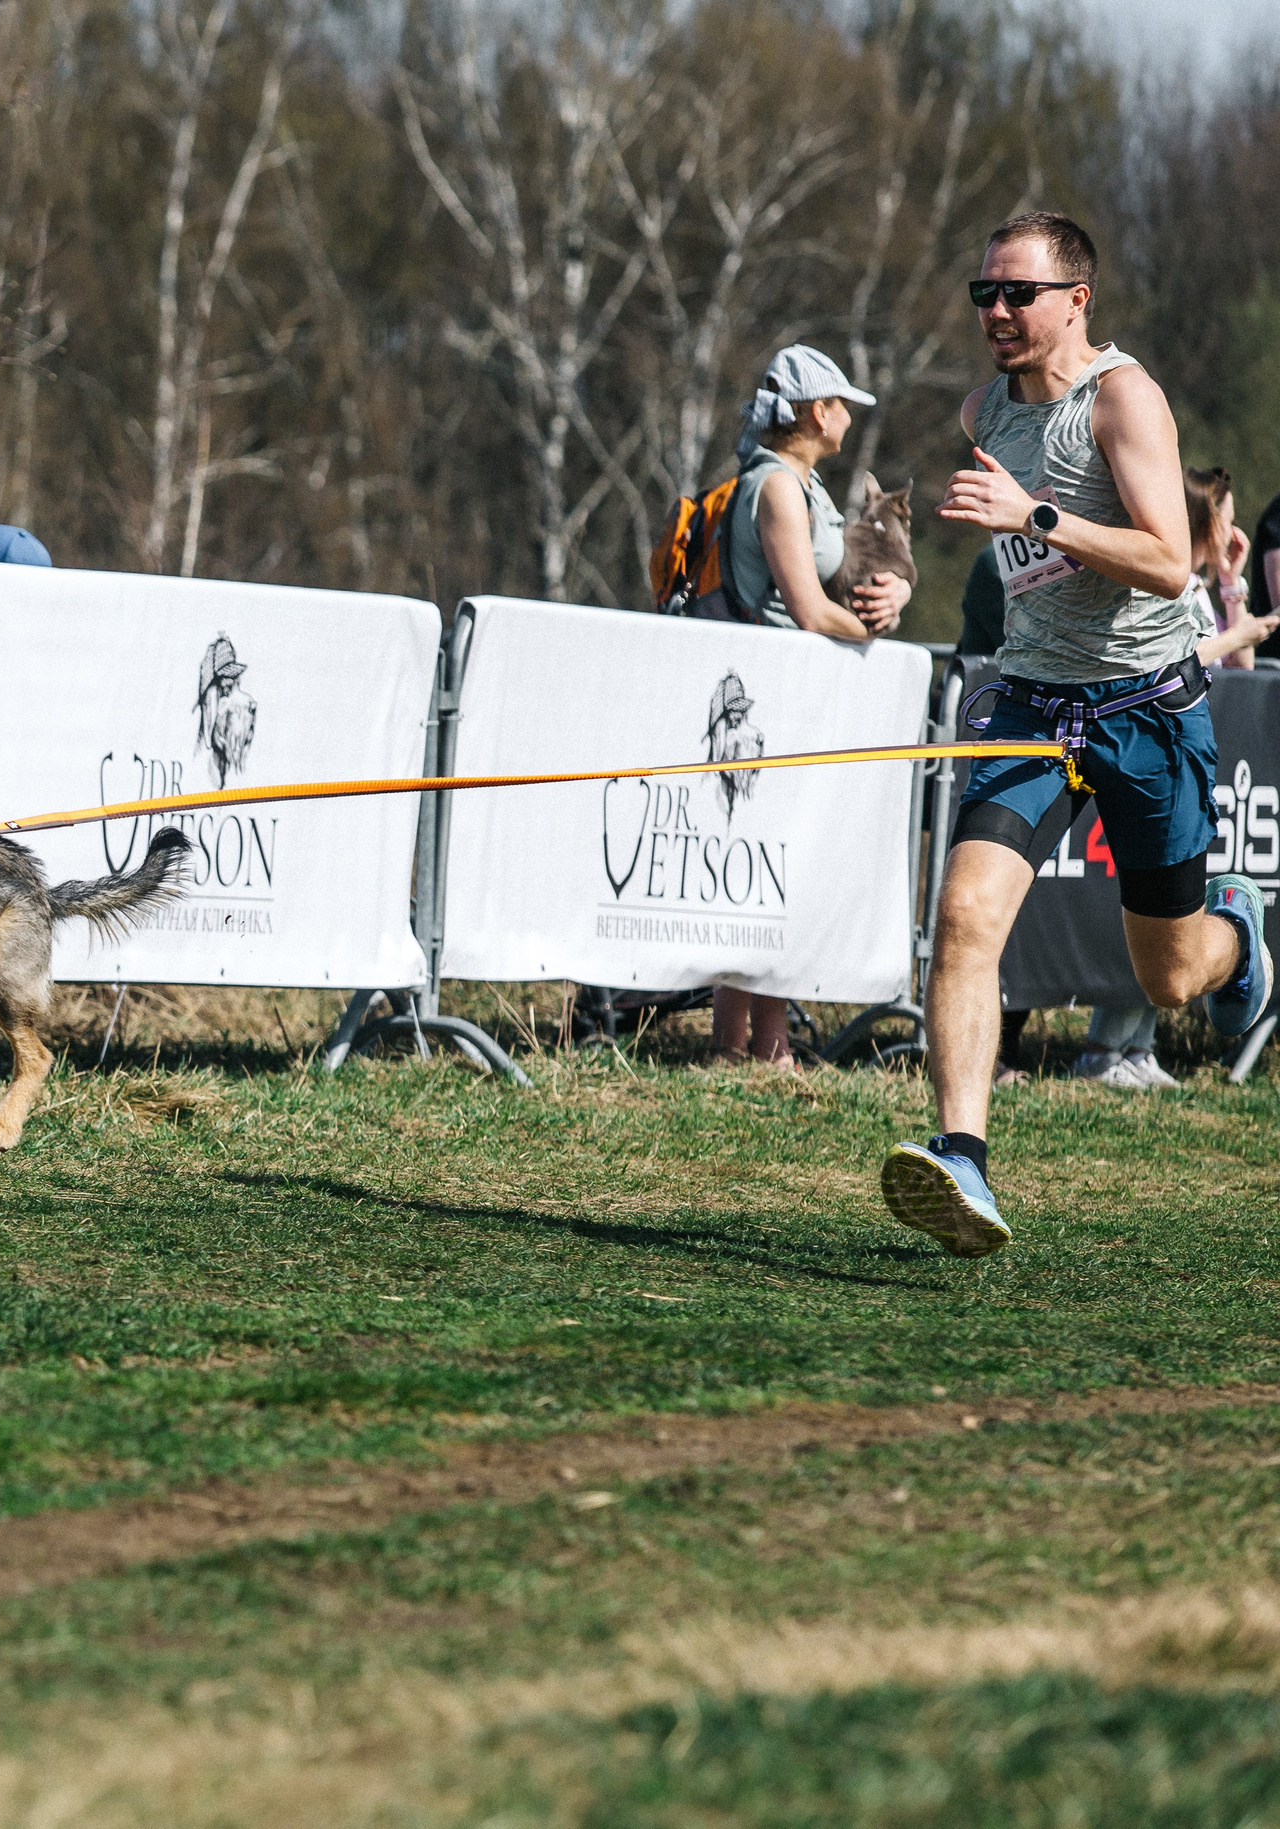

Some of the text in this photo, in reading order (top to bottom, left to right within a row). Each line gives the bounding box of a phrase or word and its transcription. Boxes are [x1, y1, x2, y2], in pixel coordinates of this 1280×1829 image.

[653, 783, 698, 832] DR.
[596, 914, 785, 950] ВЕТЕРИНАРНАЯ КЛИНИКА
